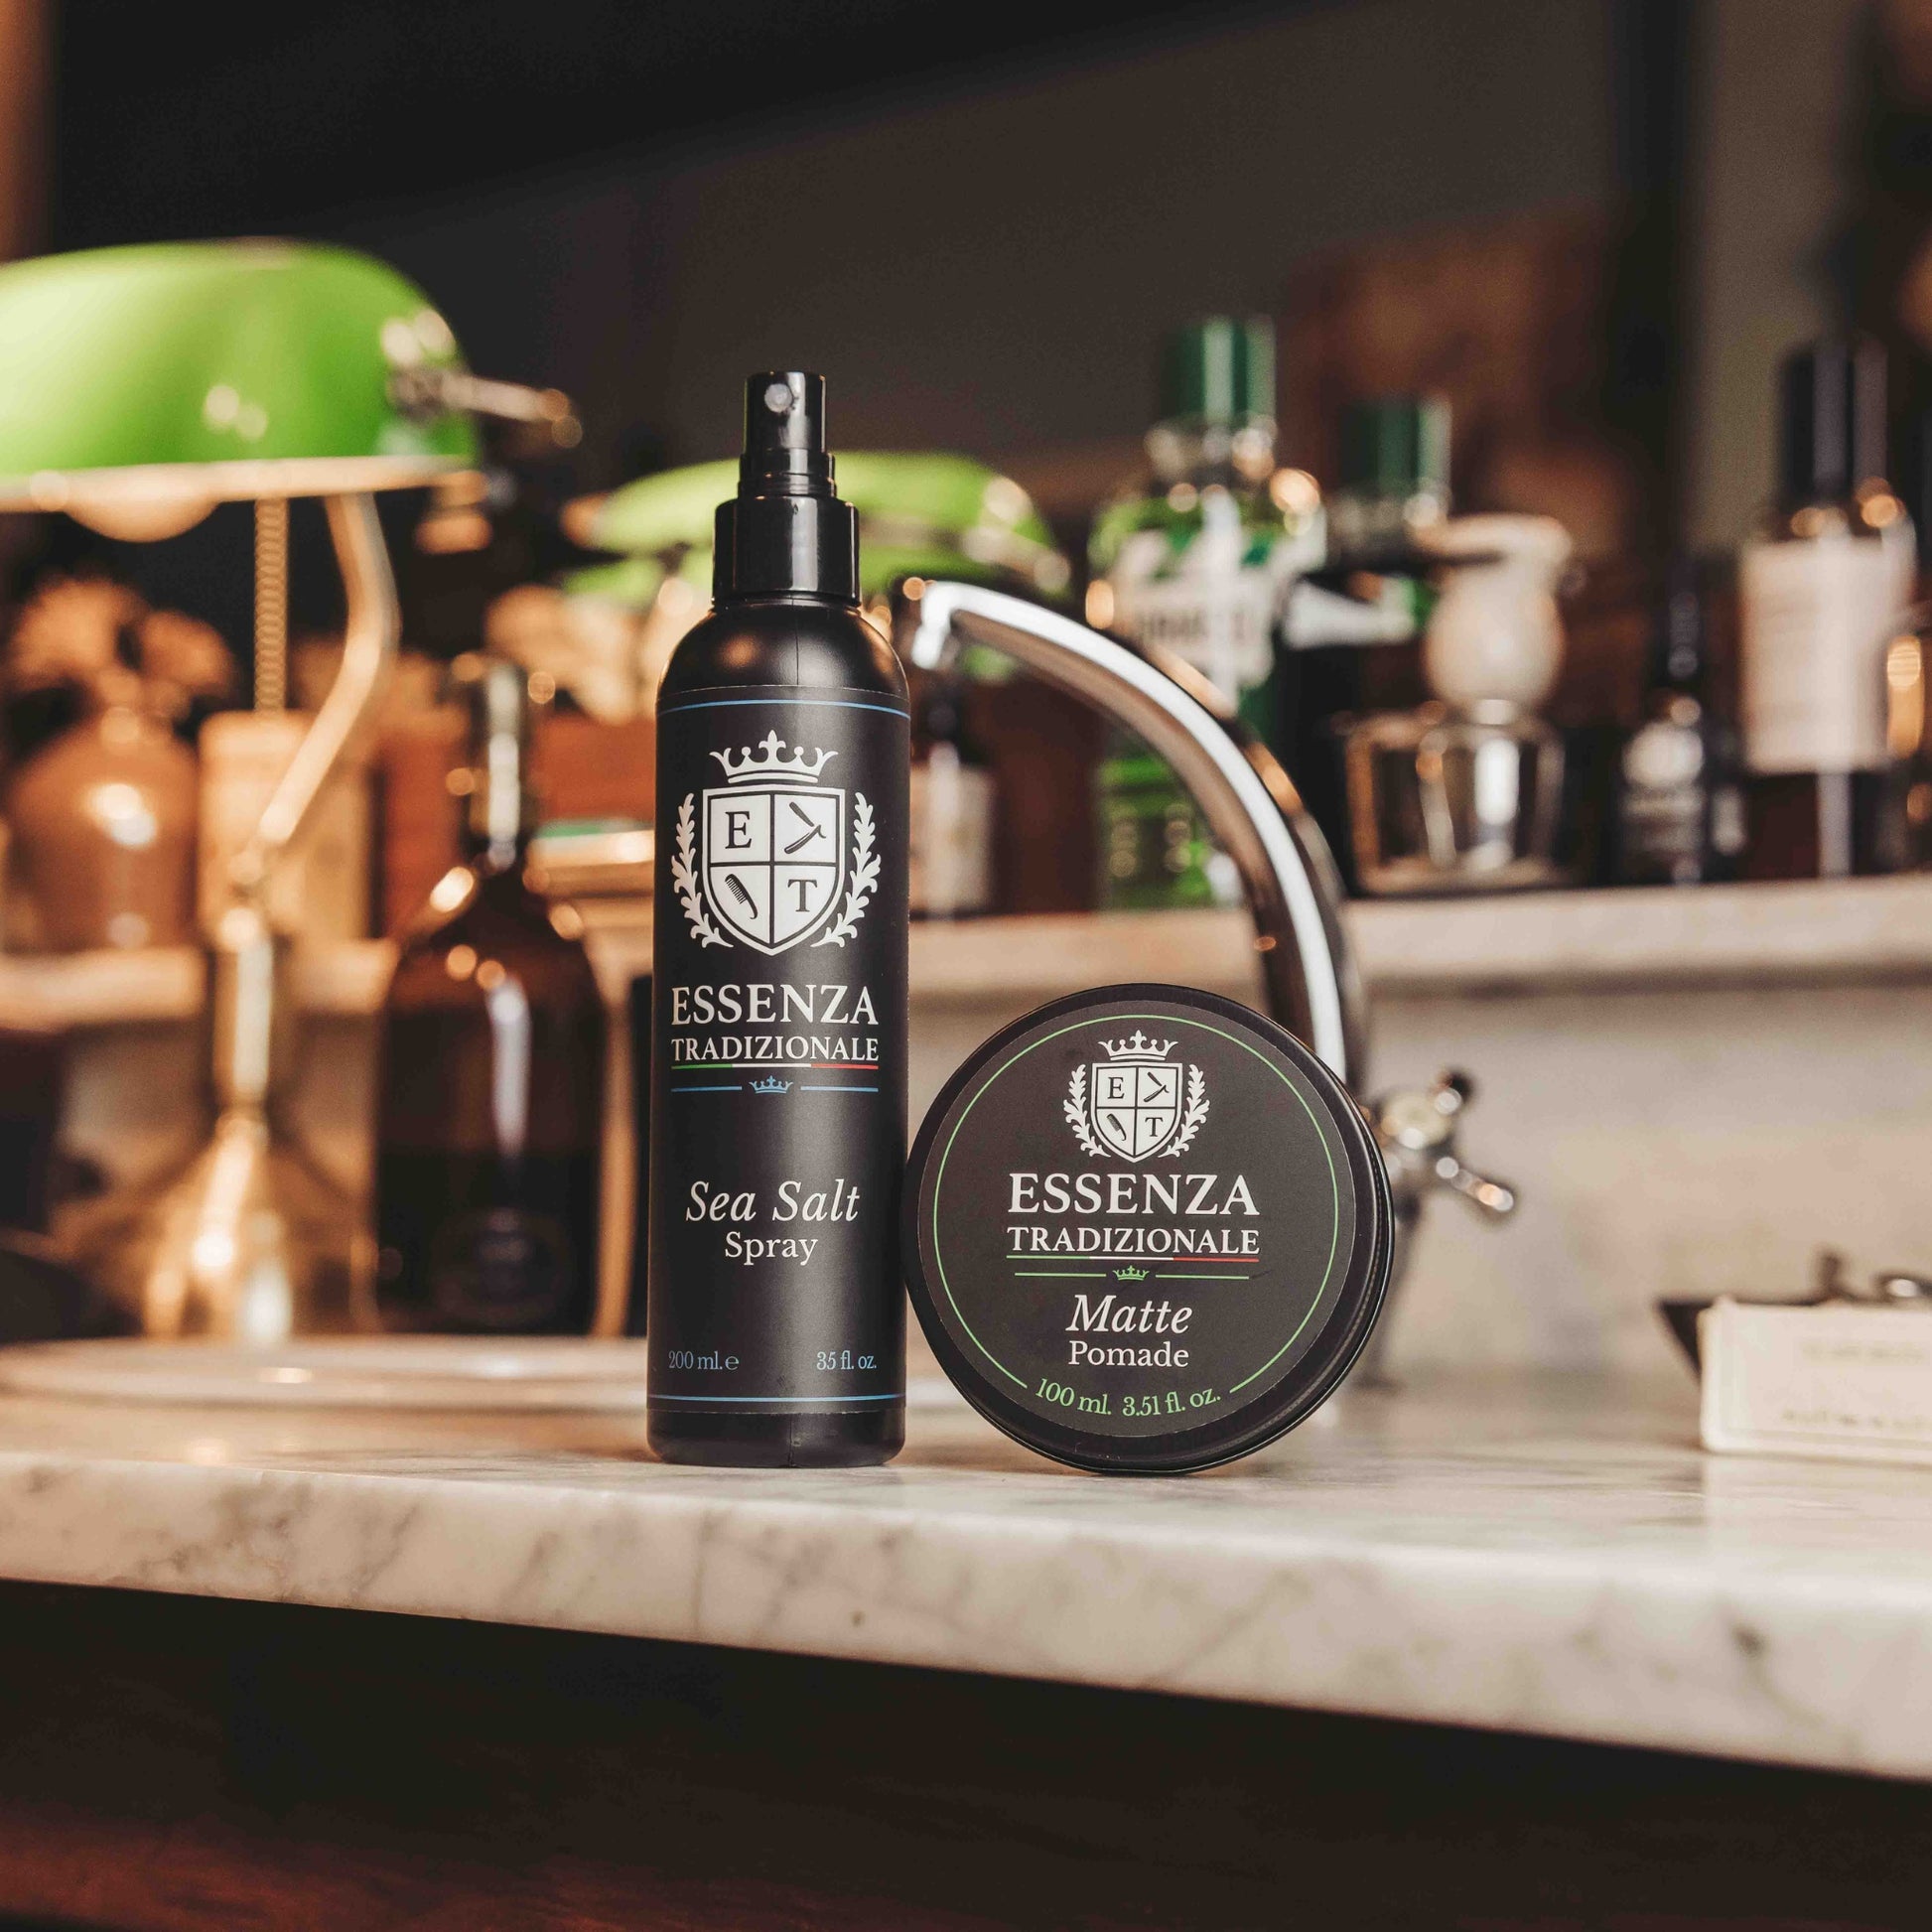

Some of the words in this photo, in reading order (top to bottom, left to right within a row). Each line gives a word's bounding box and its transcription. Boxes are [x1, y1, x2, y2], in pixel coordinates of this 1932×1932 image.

[724, 810, 753, 850] E
[787, 879, 818, 912] T
[670, 983, 880, 1026] ESSENZA
[670, 1035, 880, 1061] TRADIZIONALE
[1106, 1075, 1126, 1100] E
[1144, 1116, 1164, 1138] T
[685, 1180, 758, 1222] Sea
[771, 1178, 861, 1222] Salt
[1007, 1172, 1261, 1216] ESSENZA
[724, 1230, 819, 1267] Spray
[1006, 1226, 1260, 1255] TRADIZIONALE
[1064, 1294, 1193, 1334] Matte
[668, 1350, 694, 1370] 200
[840, 1350, 855, 1371] fl.
[857, 1355, 878, 1370] oz.
[1067, 1340, 1189, 1367] Pomade
[1035, 1378, 1074, 1407] 100
[1076, 1394, 1113, 1416] ml.
[1122, 1395, 1161, 1417] 3.51
[1165, 1391, 1185, 1414] fl.
[1189, 1387, 1221, 1409] oz.
